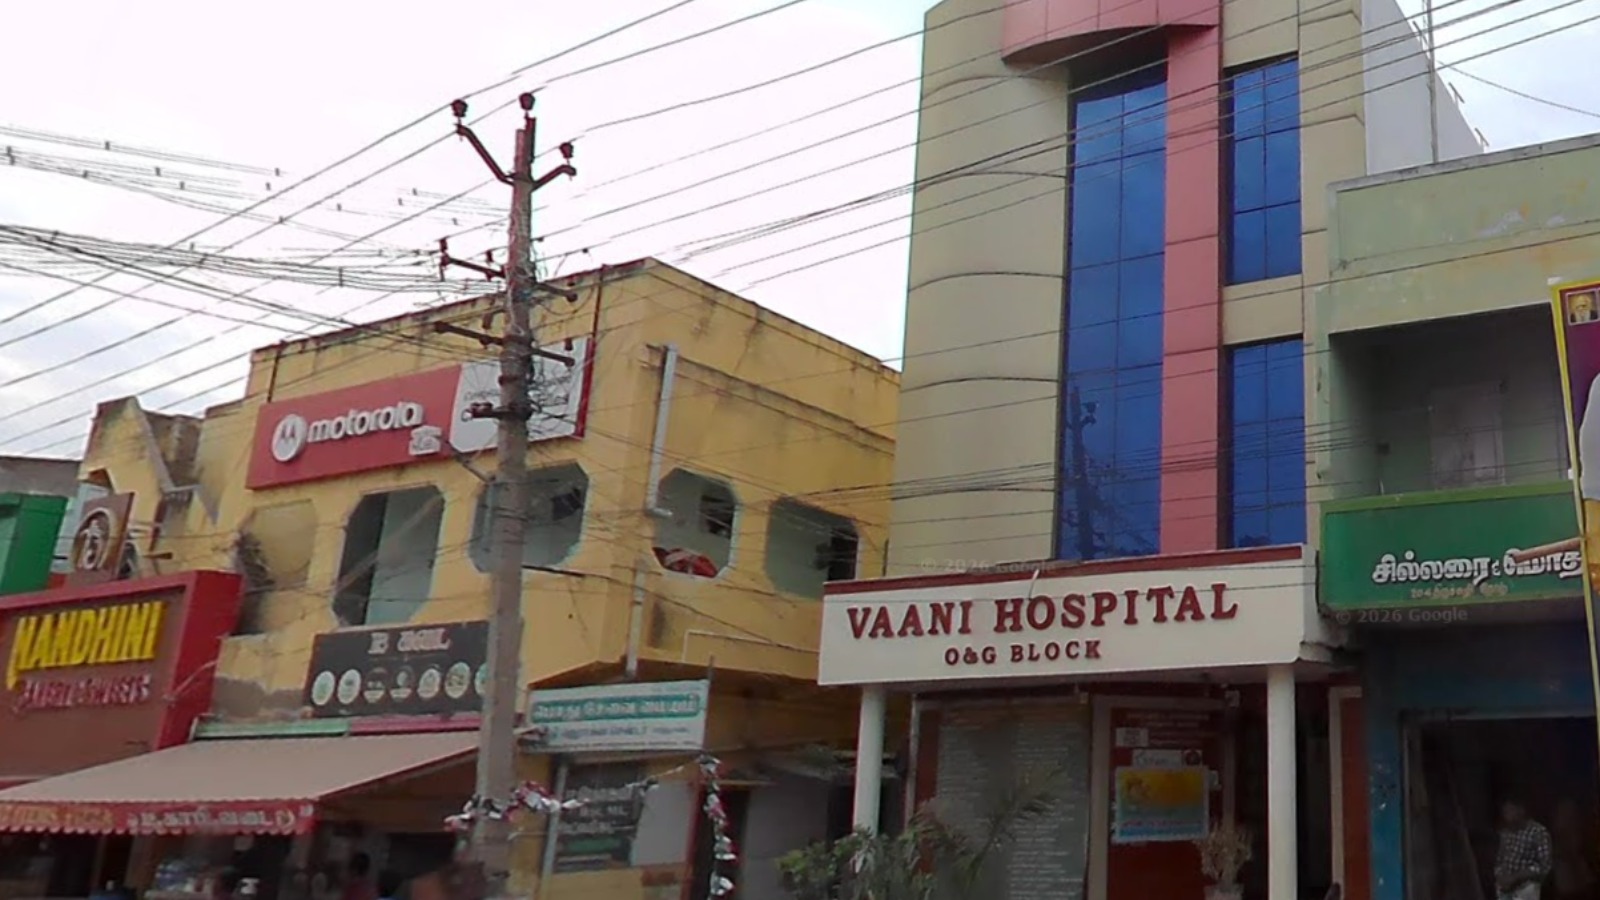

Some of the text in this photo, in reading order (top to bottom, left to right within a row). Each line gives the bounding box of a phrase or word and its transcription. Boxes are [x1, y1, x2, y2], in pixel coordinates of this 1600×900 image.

[307, 402, 423, 443] motorola
[1372, 550, 1491, 586] சில்லரை
[847, 583, 1238, 638] VAANI HOSPITAL
[7, 600, 166, 690] NANDHINI
[944, 641, 1101, 665] O&G BLOCK
